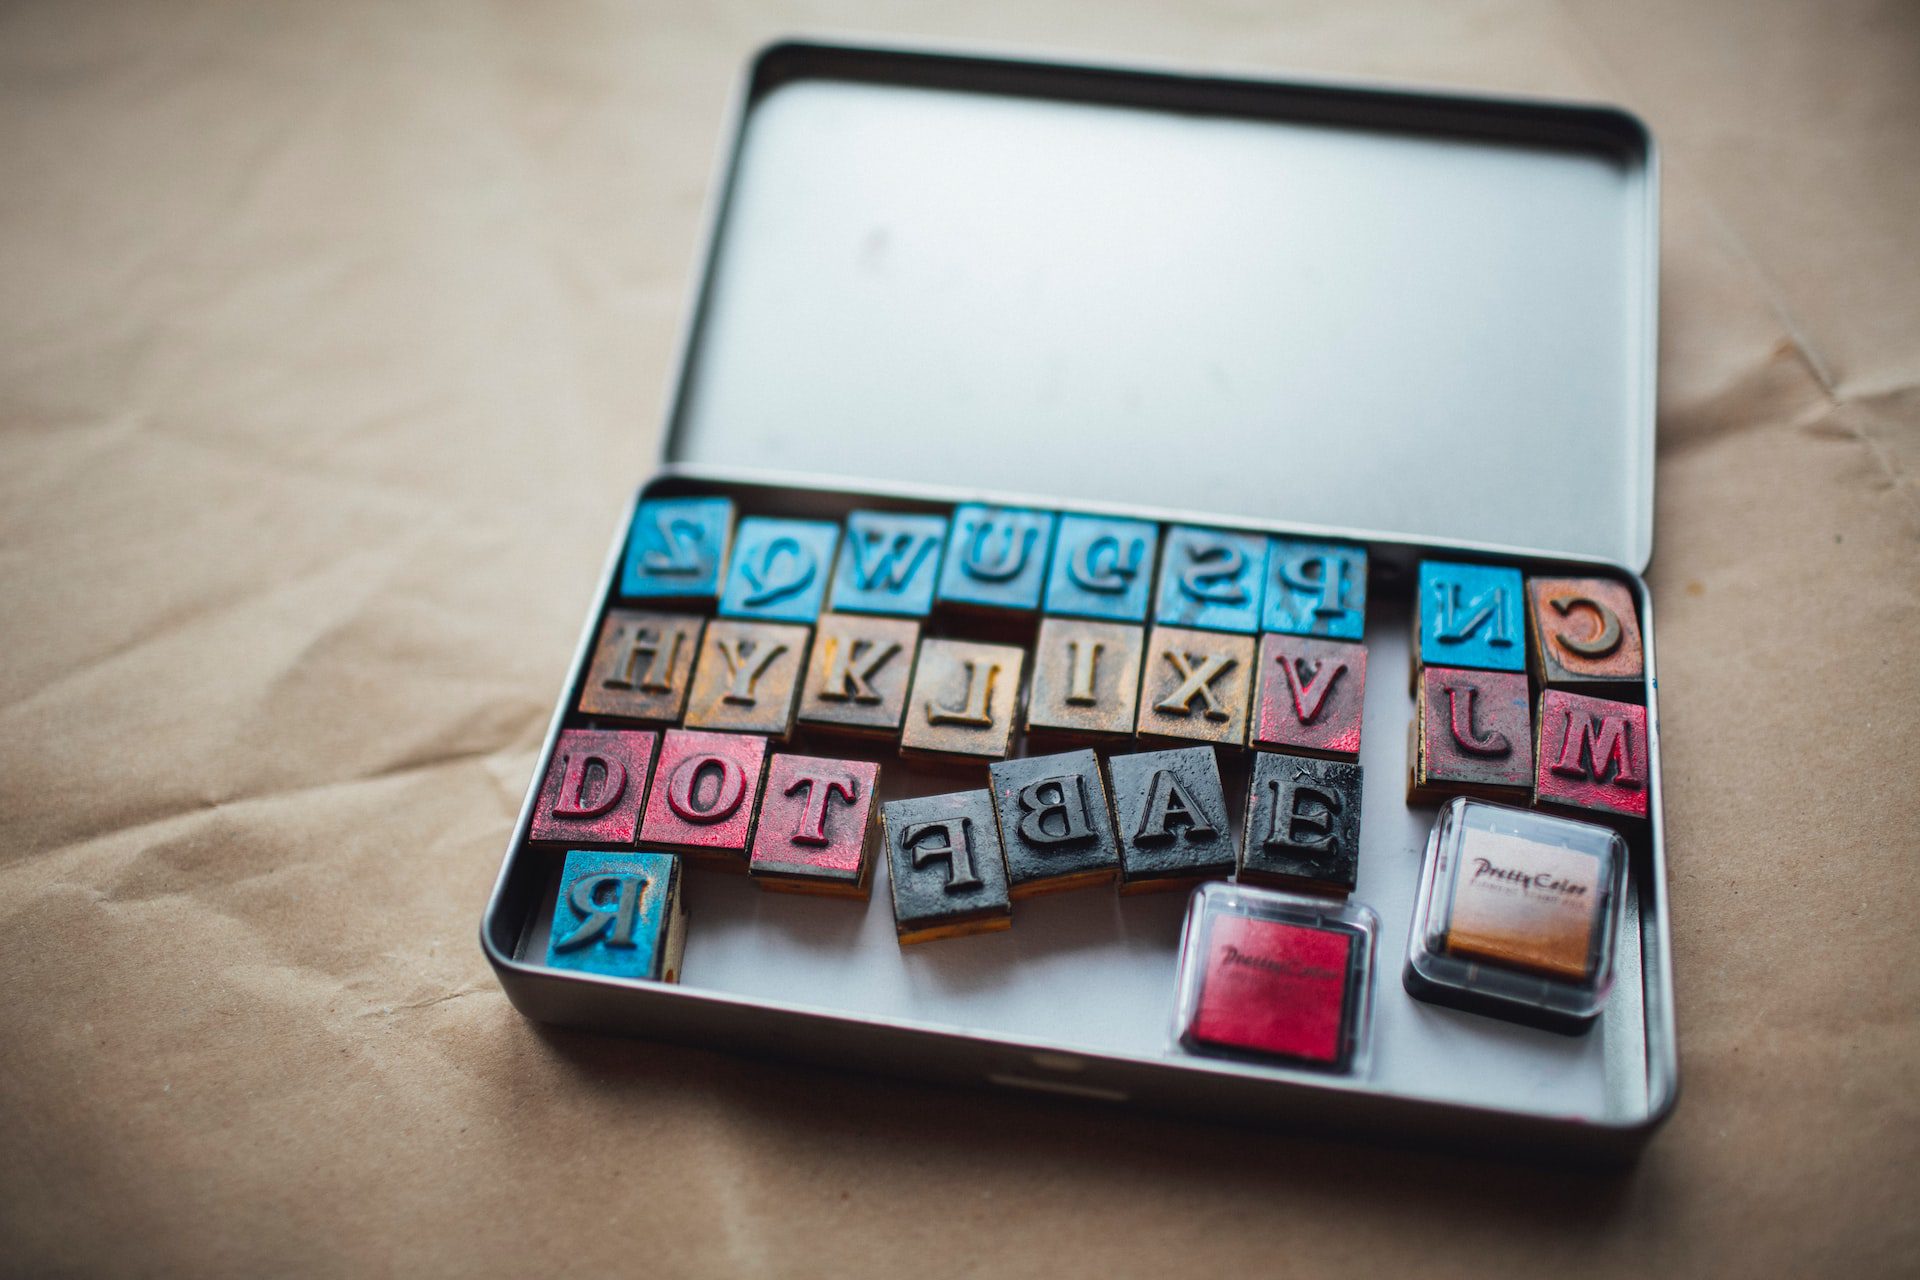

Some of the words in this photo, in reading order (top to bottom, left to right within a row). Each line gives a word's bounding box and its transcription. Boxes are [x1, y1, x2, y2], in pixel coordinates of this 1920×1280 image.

[850, 524, 940, 592] W
[960, 520, 1040, 582] U
[602, 626, 686, 694] H
[717, 638, 788, 706] Y
[817, 636, 904, 706] K
[1153, 649, 1240, 723] X
[1275, 654, 1348, 726] V
[1551, 709, 1642, 791] M
[551, 753, 628, 820] D
[667, 753, 748, 825] O
[783, 772, 857, 847] T
[1133, 769, 1220, 848] A
[1262, 778, 1344, 856] E
